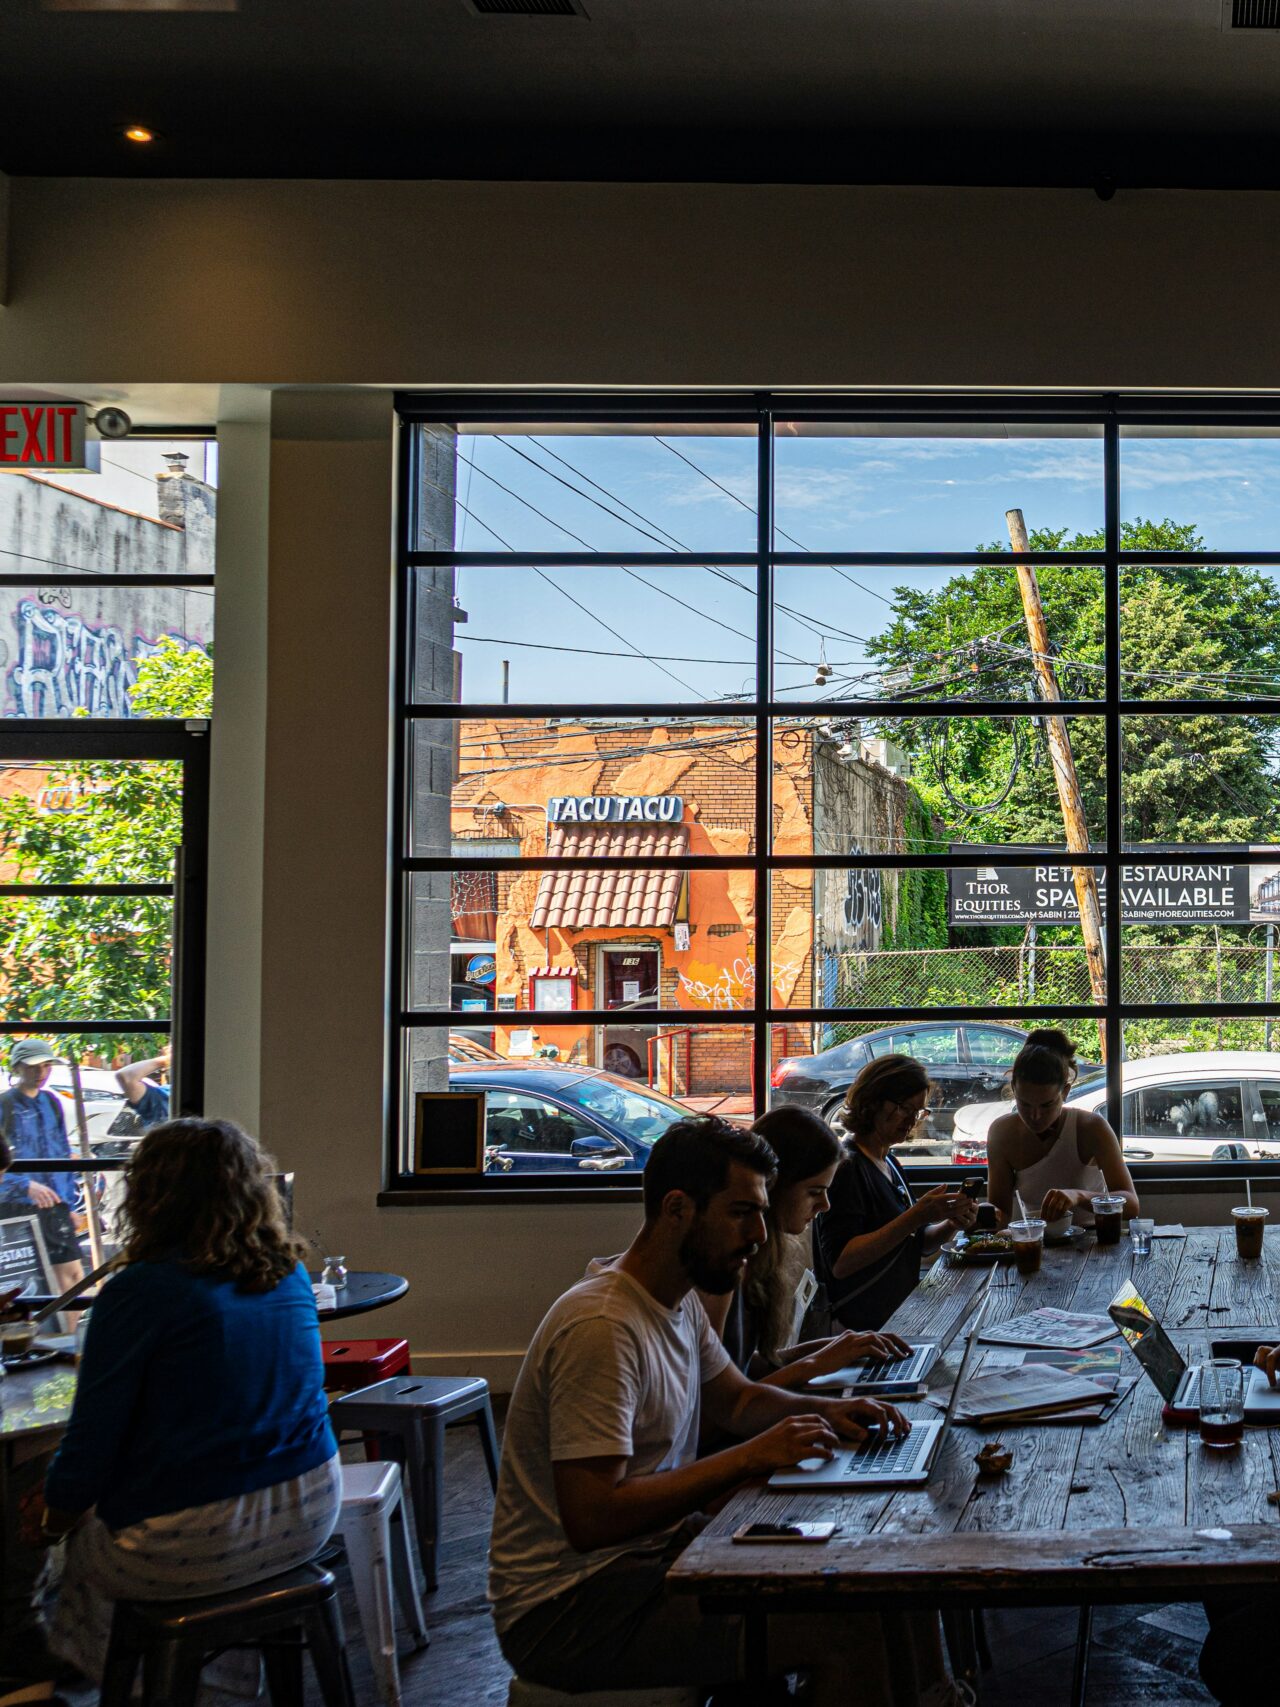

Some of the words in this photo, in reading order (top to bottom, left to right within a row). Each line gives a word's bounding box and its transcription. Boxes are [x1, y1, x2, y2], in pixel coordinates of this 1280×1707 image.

[0, 407, 77, 463] EXIT
[552, 797, 610, 821] TACU
[616, 797, 676, 821] TACU
[965, 882, 1010, 895] THOR
[1035, 888, 1107, 907] SPAE
[954, 899, 1021, 914] EQUITIES
[1019, 911, 1037, 919] SAM
[624, 958, 639, 966] 136
